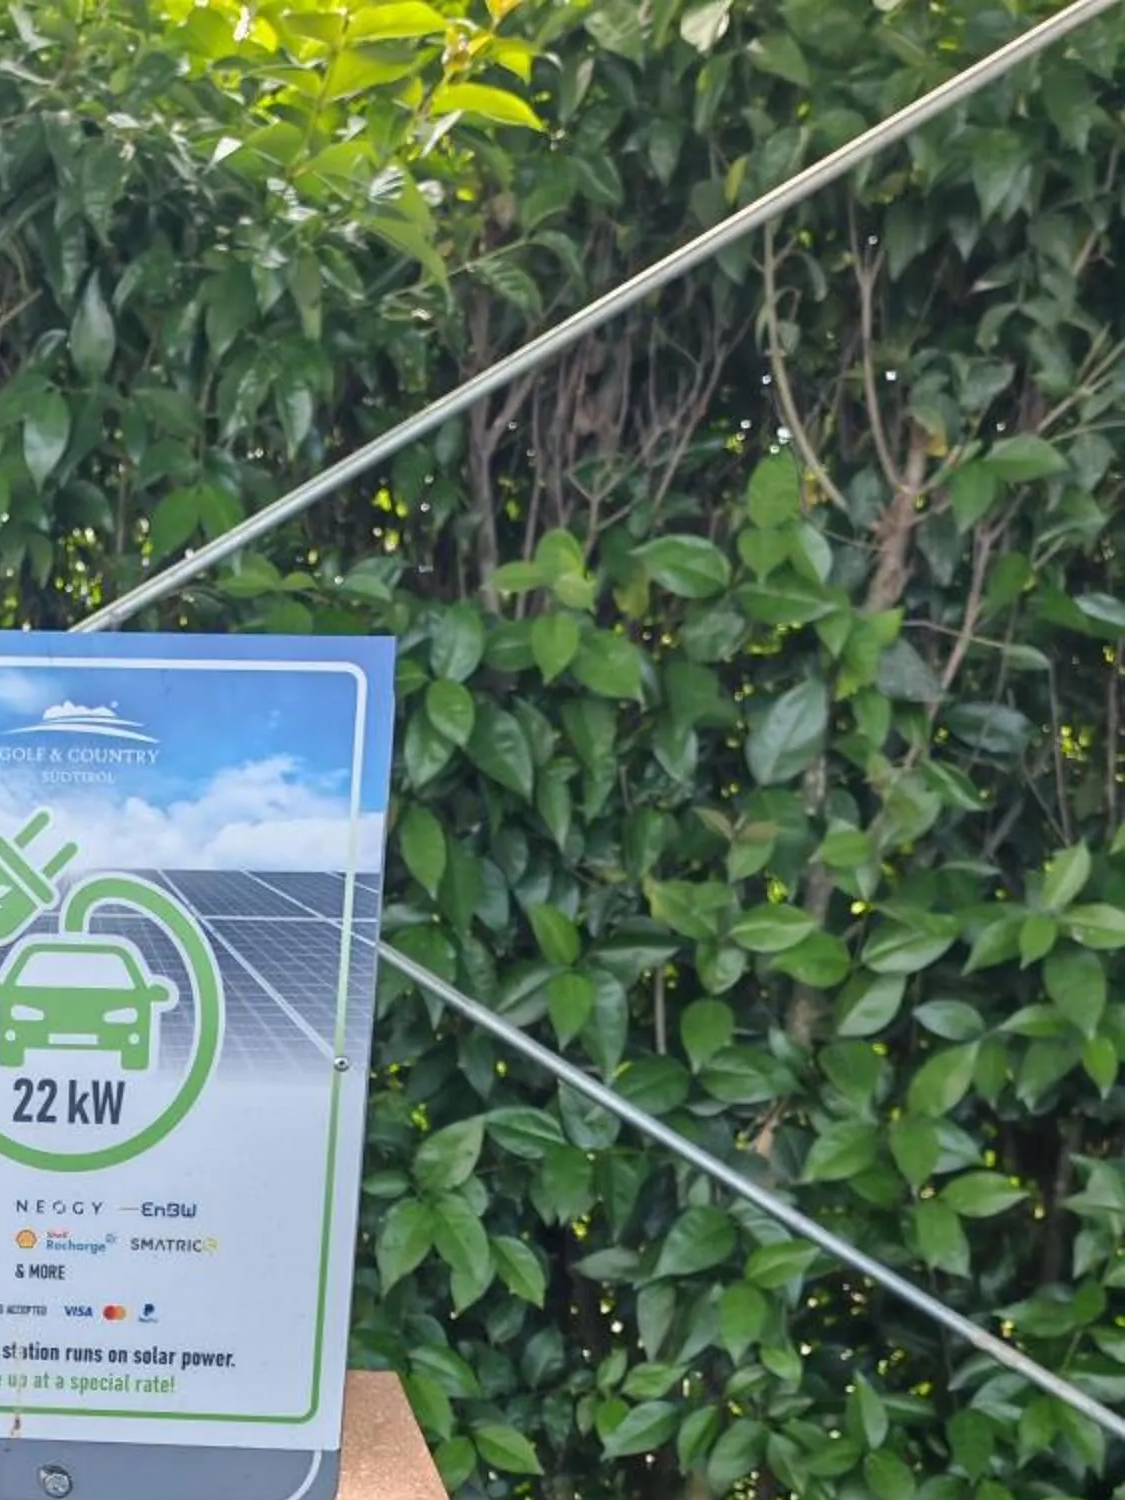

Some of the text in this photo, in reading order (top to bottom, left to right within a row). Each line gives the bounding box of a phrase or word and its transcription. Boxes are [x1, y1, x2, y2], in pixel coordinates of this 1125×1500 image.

[49, 749, 63, 763] &
[68, 749, 160, 764] COUNTRY
[12, 1077, 125, 1125] 22 kW
[141, 1202, 197, 1218] EnBW
[46, 1239, 107, 1255] Recharge
[15, 1264, 66, 1280] & MORE
[64, 1305, 93, 1317] VISA
[65, 1347, 103, 1363] runs
[108, 1349, 128, 1364] on
[133, 1345, 176, 1365] solar
[181, 1351, 236, 1370] power.
[34, 1371, 50, 1389] at
[55, 1375, 65, 1389] a
[70, 1373, 130, 1395] special
[136, 1375, 175, 1393] rate!
